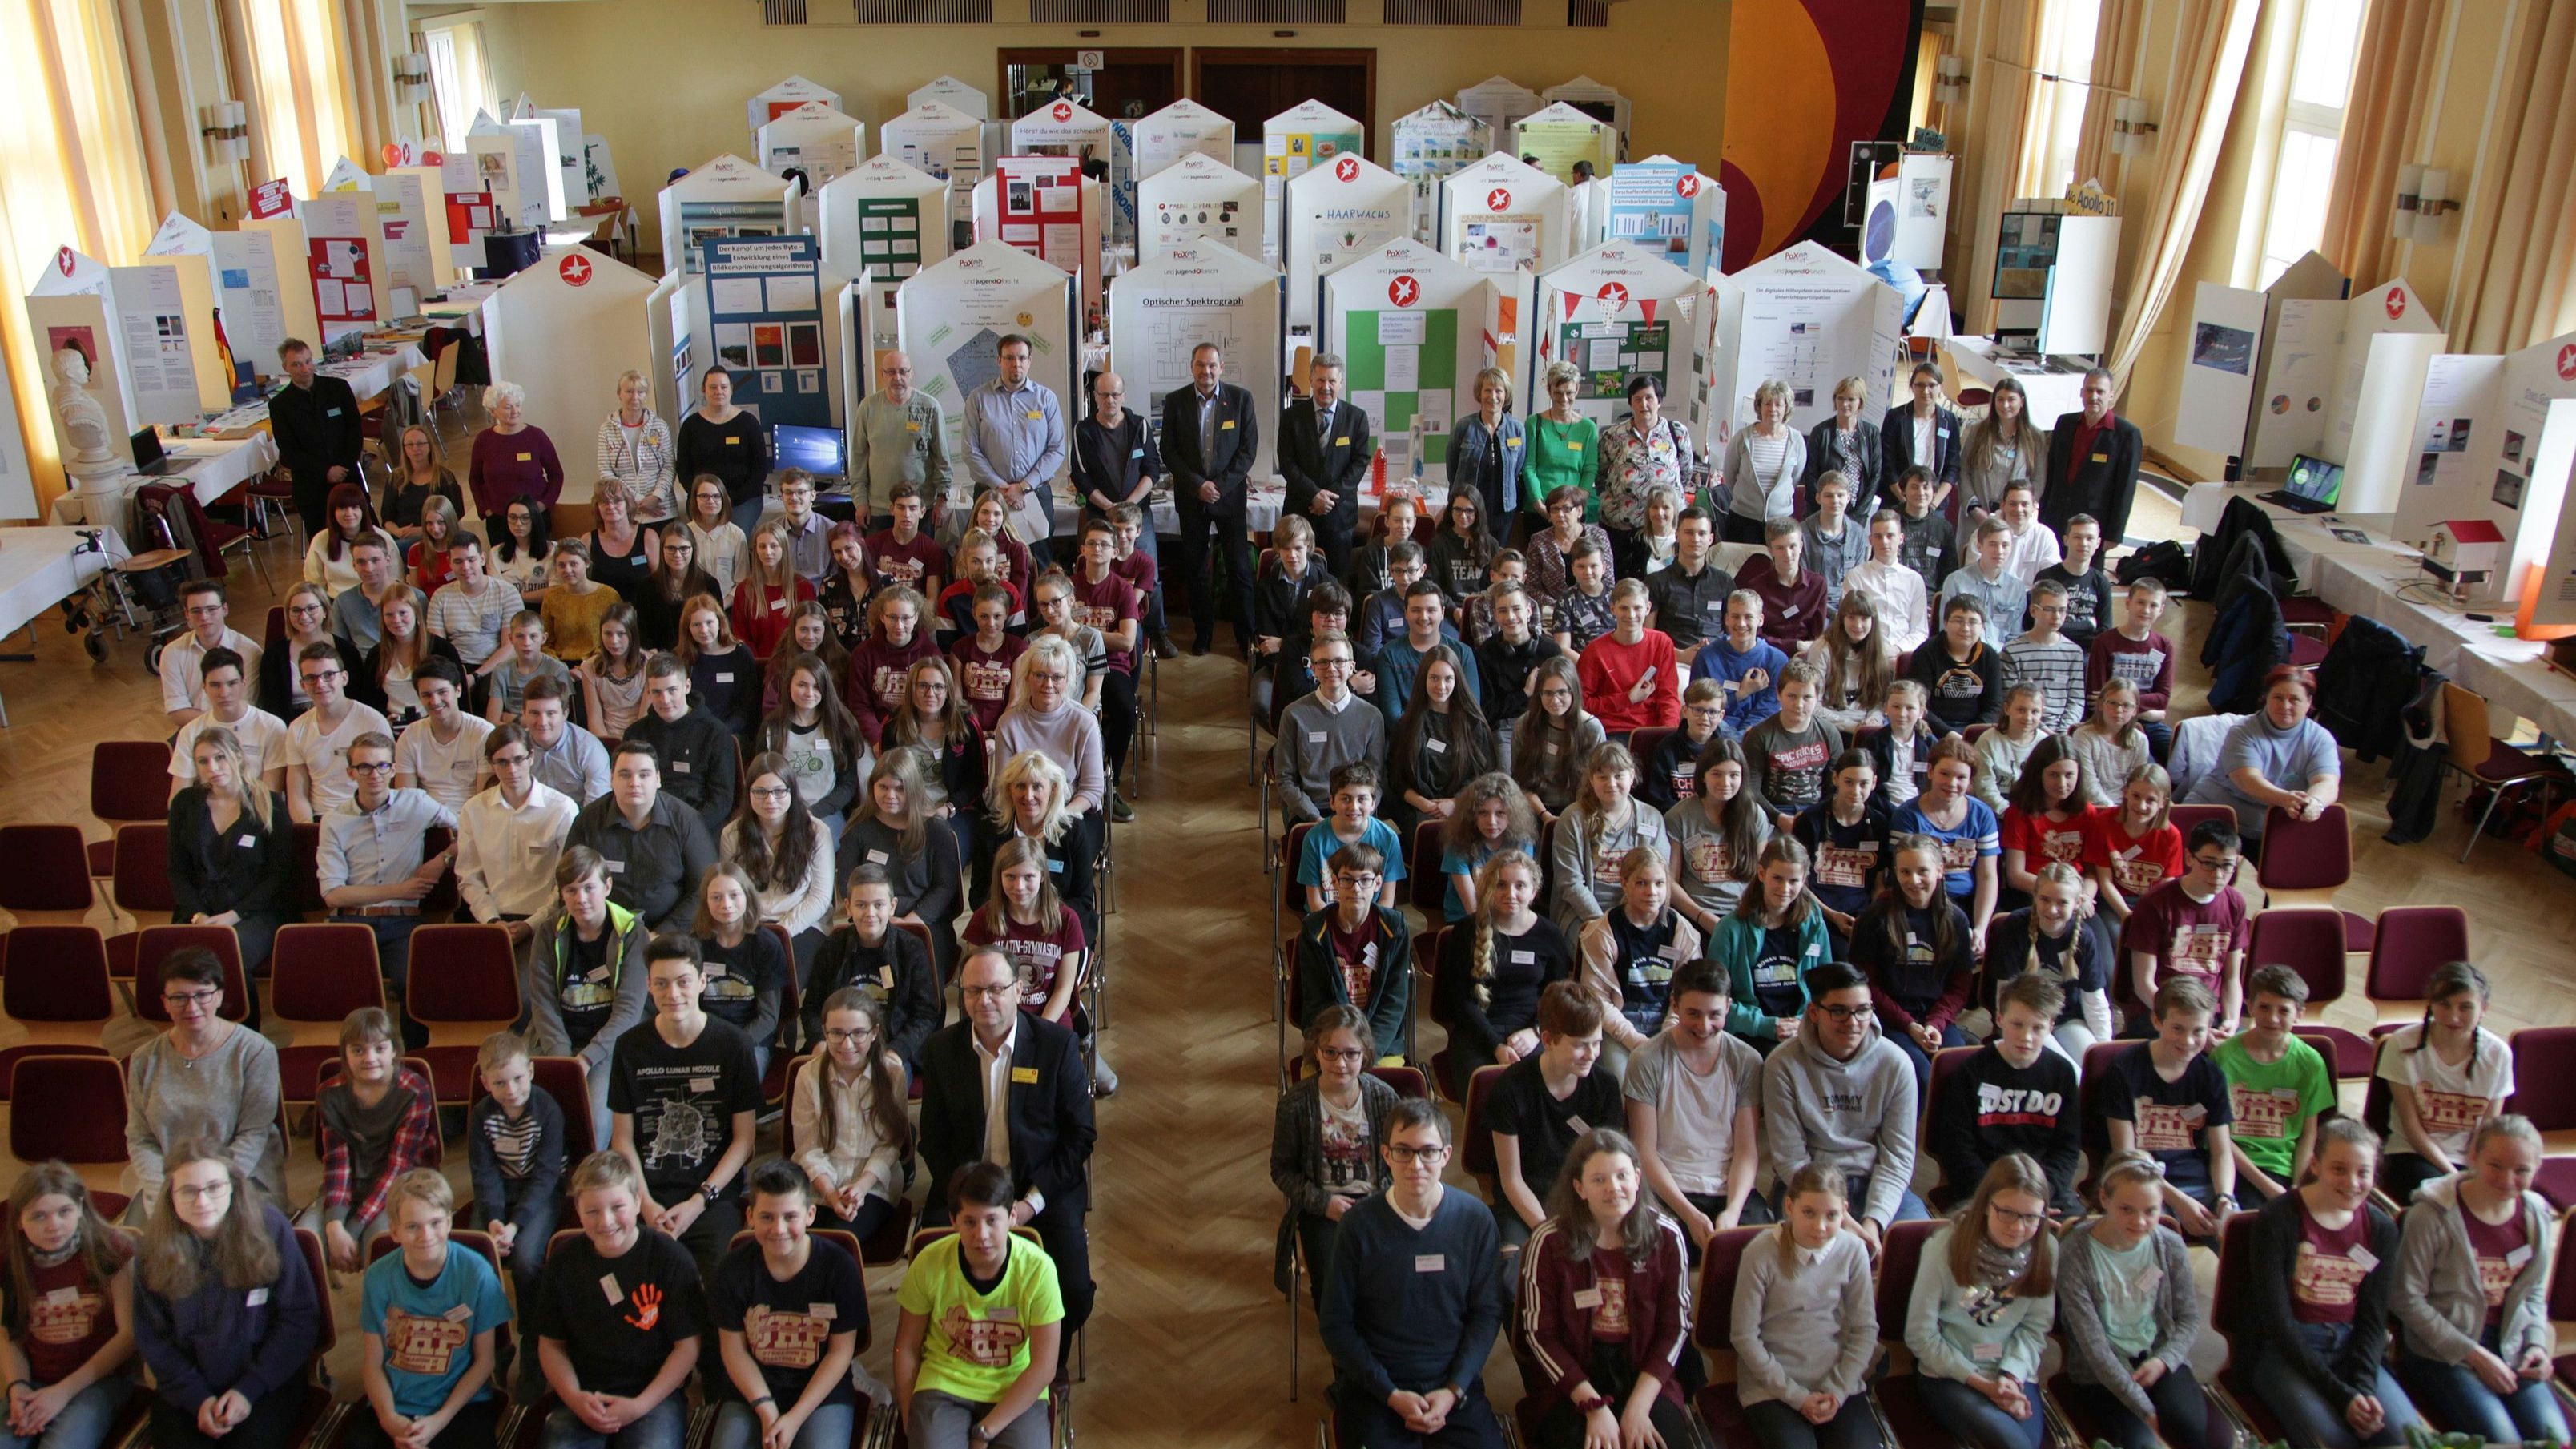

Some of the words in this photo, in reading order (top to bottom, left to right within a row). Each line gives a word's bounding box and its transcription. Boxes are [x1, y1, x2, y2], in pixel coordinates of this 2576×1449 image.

[2077, 190, 2103, 214] Apollo
[1327, 208, 1391, 220] HAARWACHS
[732, 245, 752, 253] Kampf
[765, 244, 782, 252] jedes
[733, 254, 772, 262] Entwicklung
[712, 263, 812, 272] Bildkomprimierungsalgorithmus
[1142, 296, 1184, 307] Optischer
[1185, 296, 1244, 307] Spektrograph
[1451, 566, 1483, 580] TEAM
[1774, 751, 1795, 763] EPIC
[637, 1067, 665, 1076] APOLLO
[666, 1066, 691, 1074] LUNAR
[691, 1065, 721, 1073] MODULE
[2025, 1089, 2063, 1116] DO
